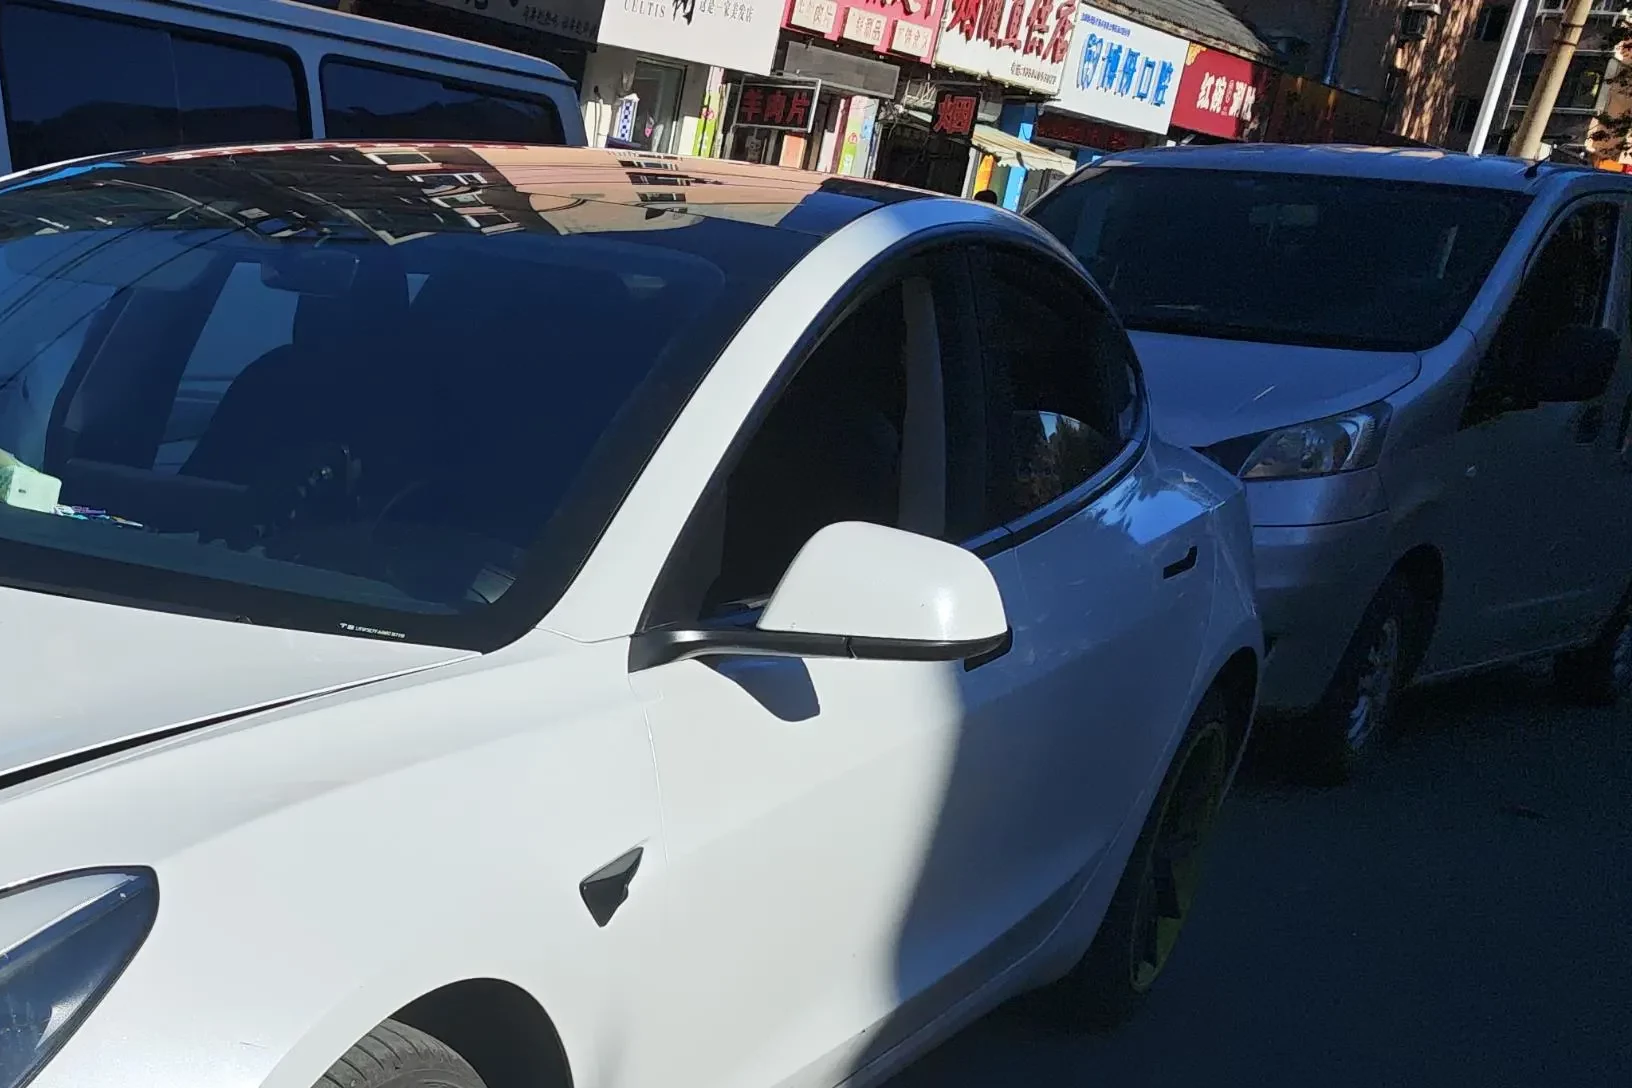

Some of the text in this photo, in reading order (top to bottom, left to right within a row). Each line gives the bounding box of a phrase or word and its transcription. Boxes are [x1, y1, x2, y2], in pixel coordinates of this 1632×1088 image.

[741, 88, 810, 125] 羊肉片
[934, 93, 977, 135] 烟
